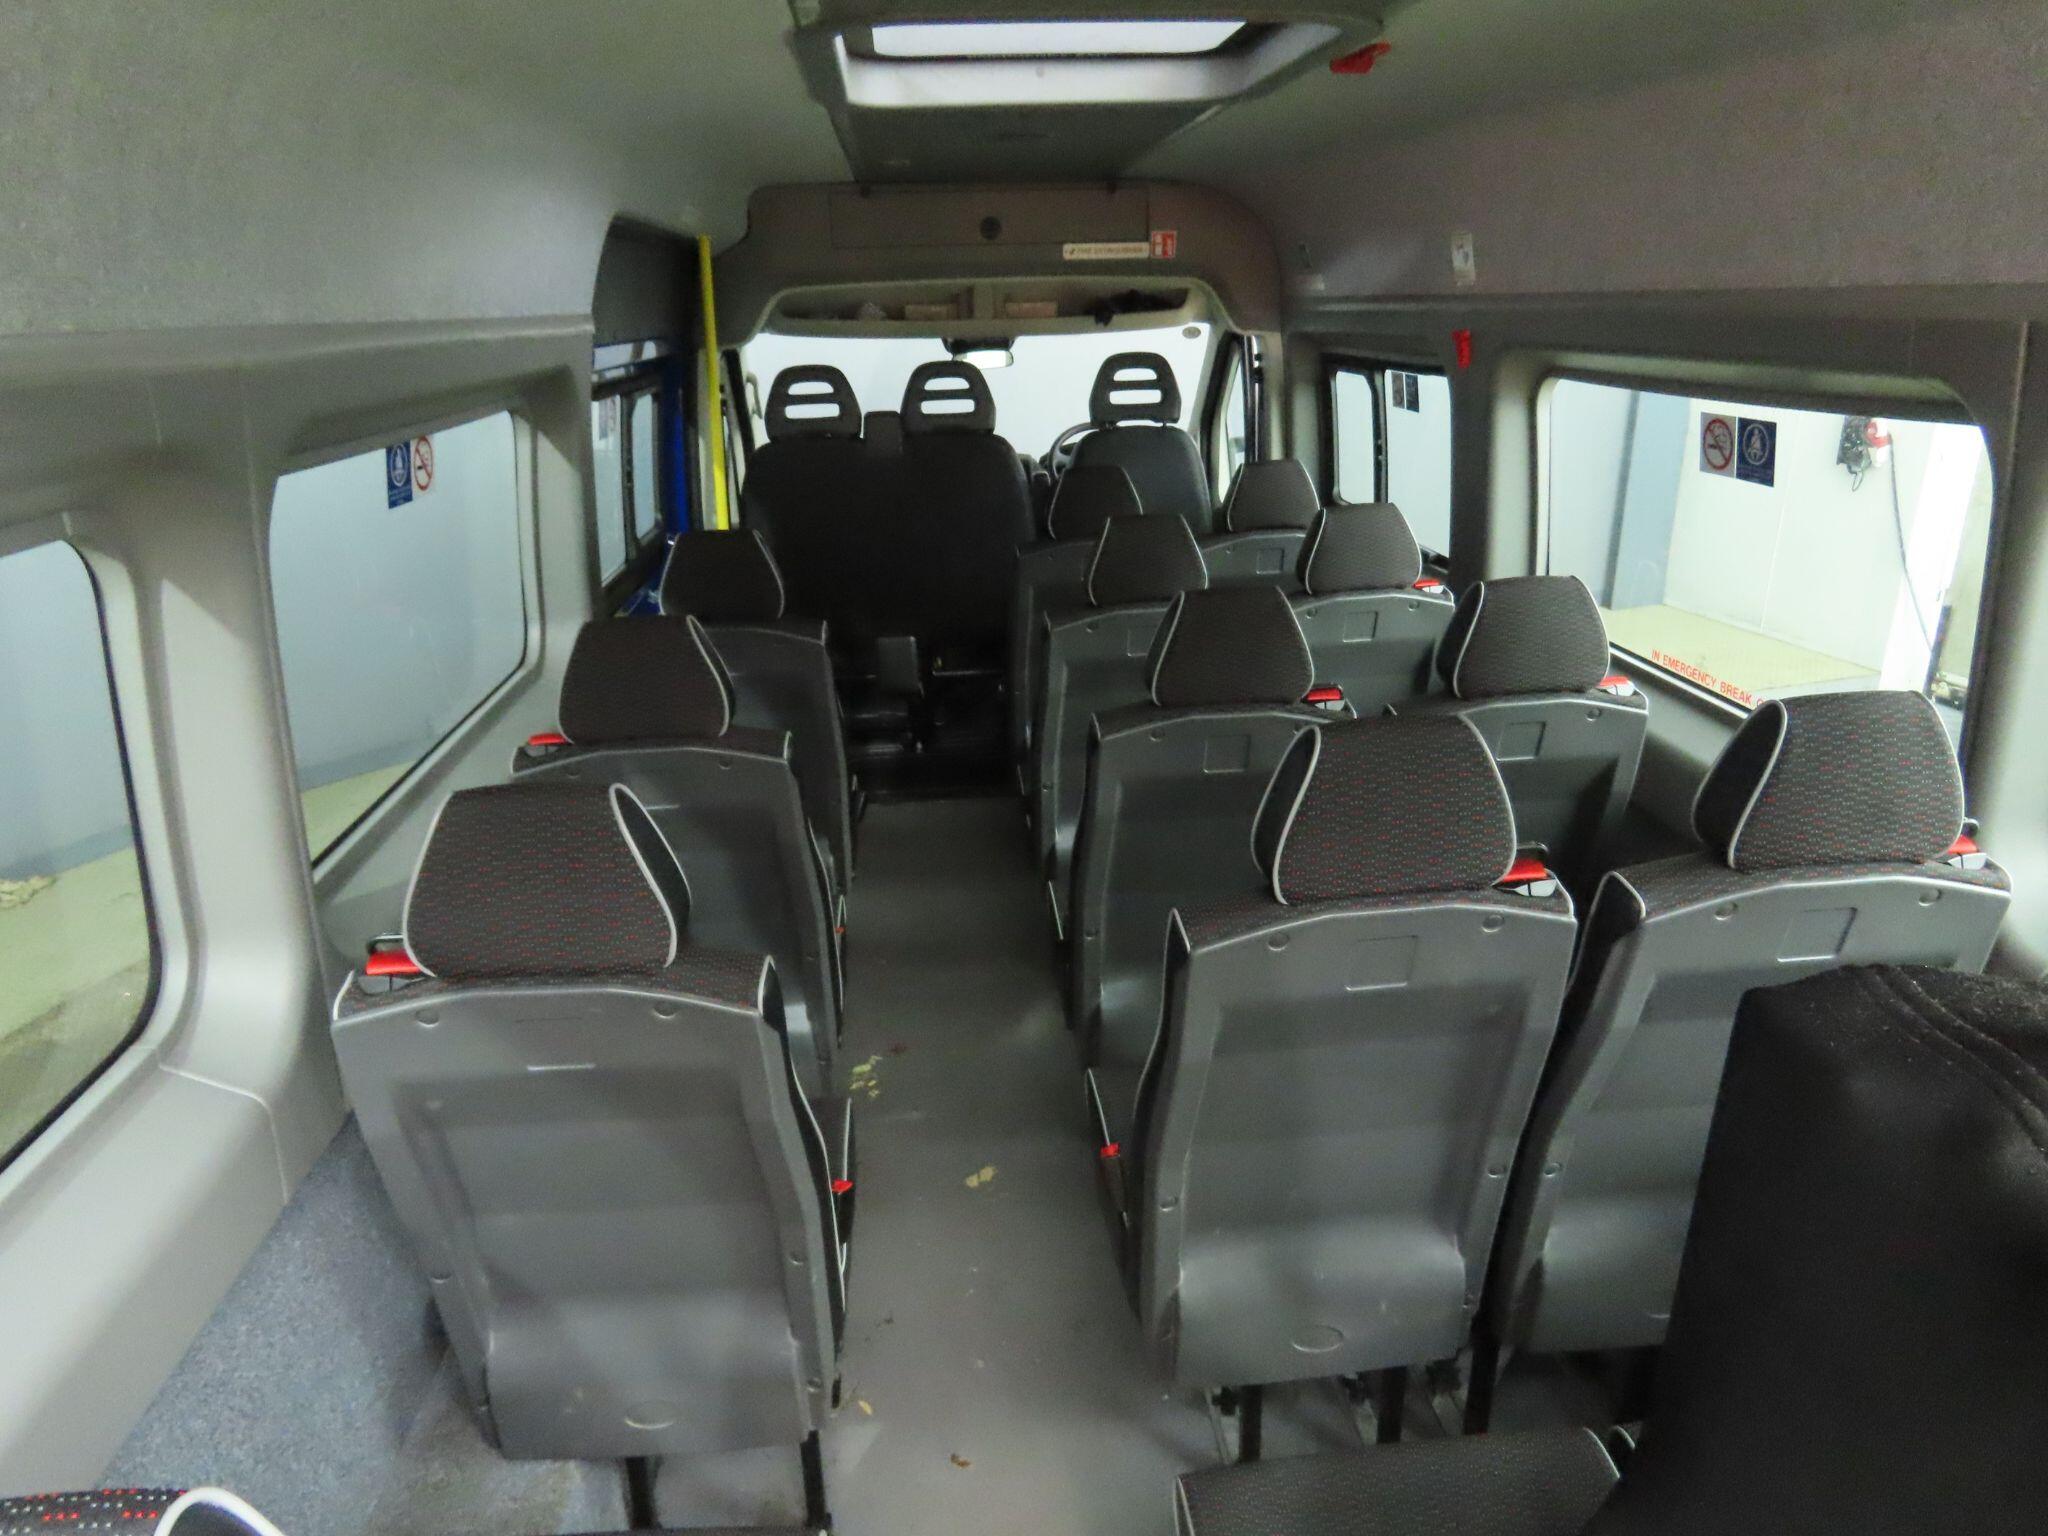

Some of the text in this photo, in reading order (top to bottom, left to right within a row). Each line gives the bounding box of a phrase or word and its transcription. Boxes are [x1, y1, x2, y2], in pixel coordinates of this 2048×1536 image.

[1651, 649, 1753, 705] IN EMERGENCY BREAK
